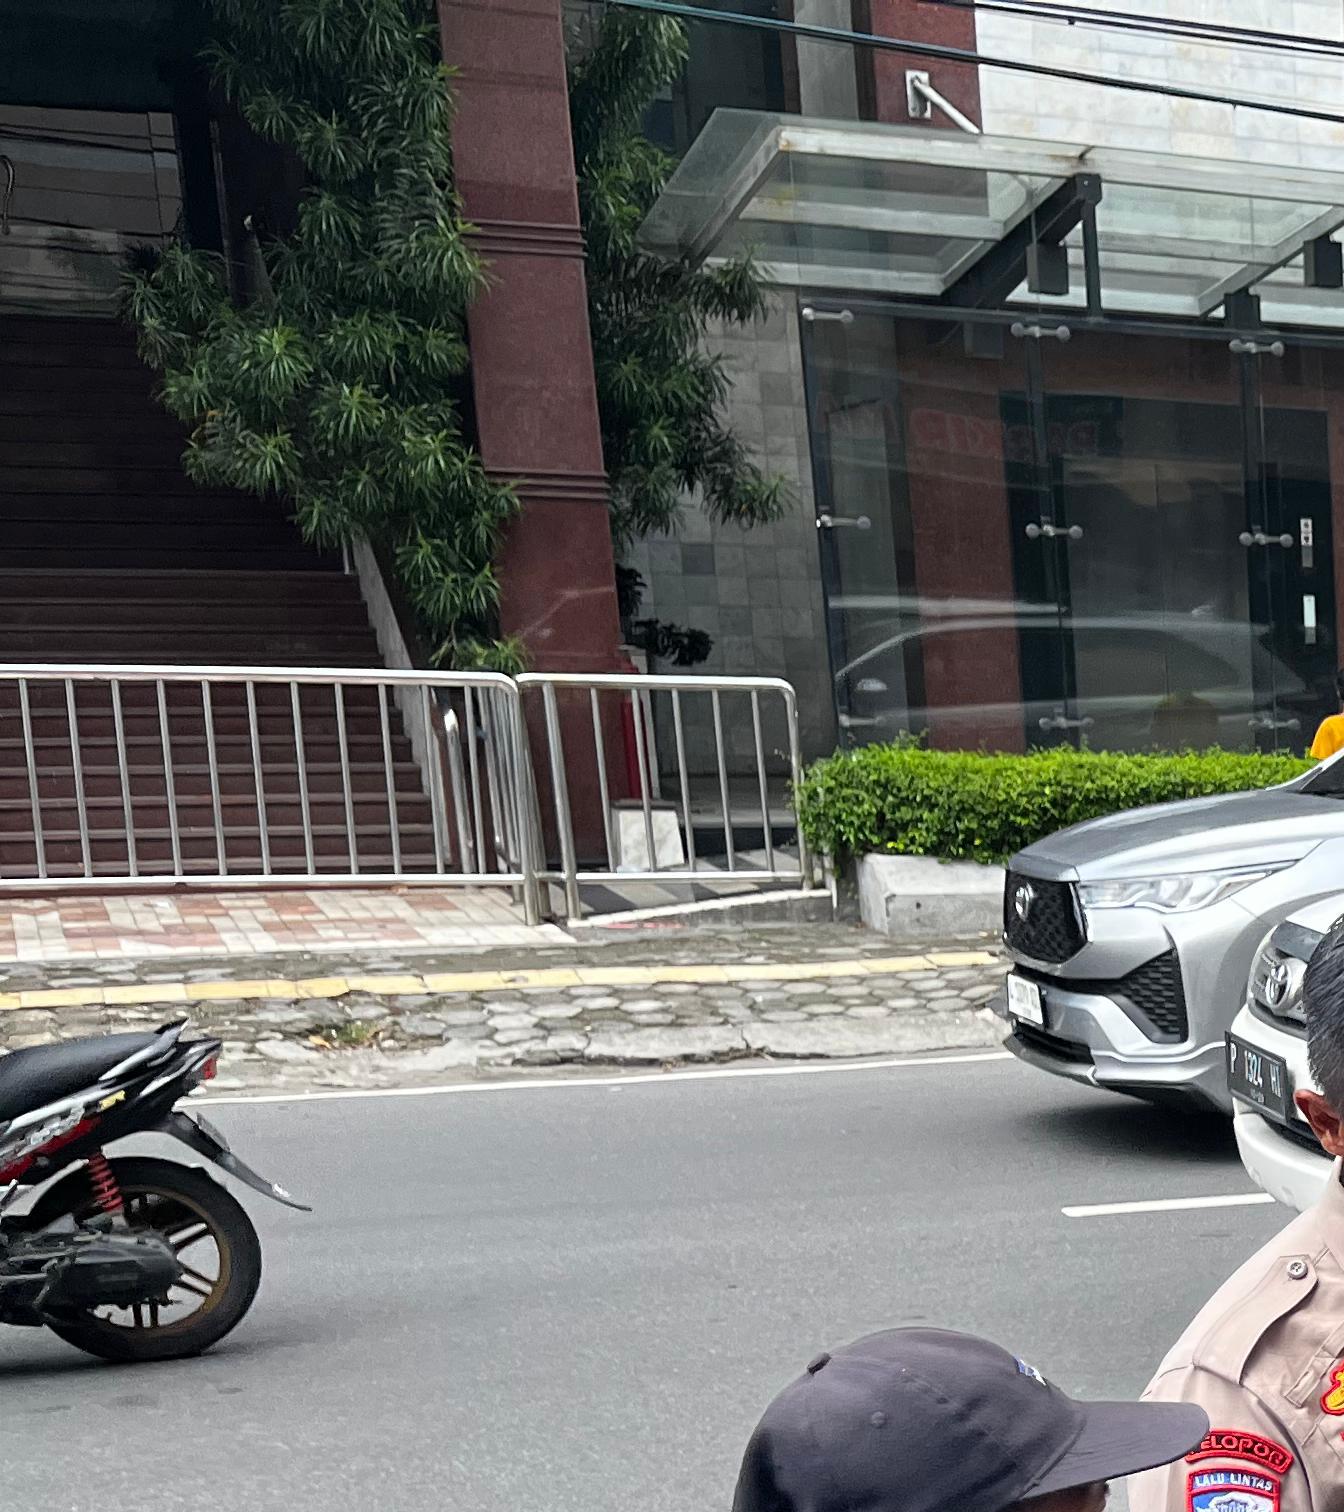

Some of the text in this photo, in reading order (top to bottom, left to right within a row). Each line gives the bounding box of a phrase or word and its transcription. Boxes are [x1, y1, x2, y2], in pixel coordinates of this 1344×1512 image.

[1199, 1435, 1285, 1466] ELOPOR
[1194, 1473, 1273, 1492] LALU LINTAS
